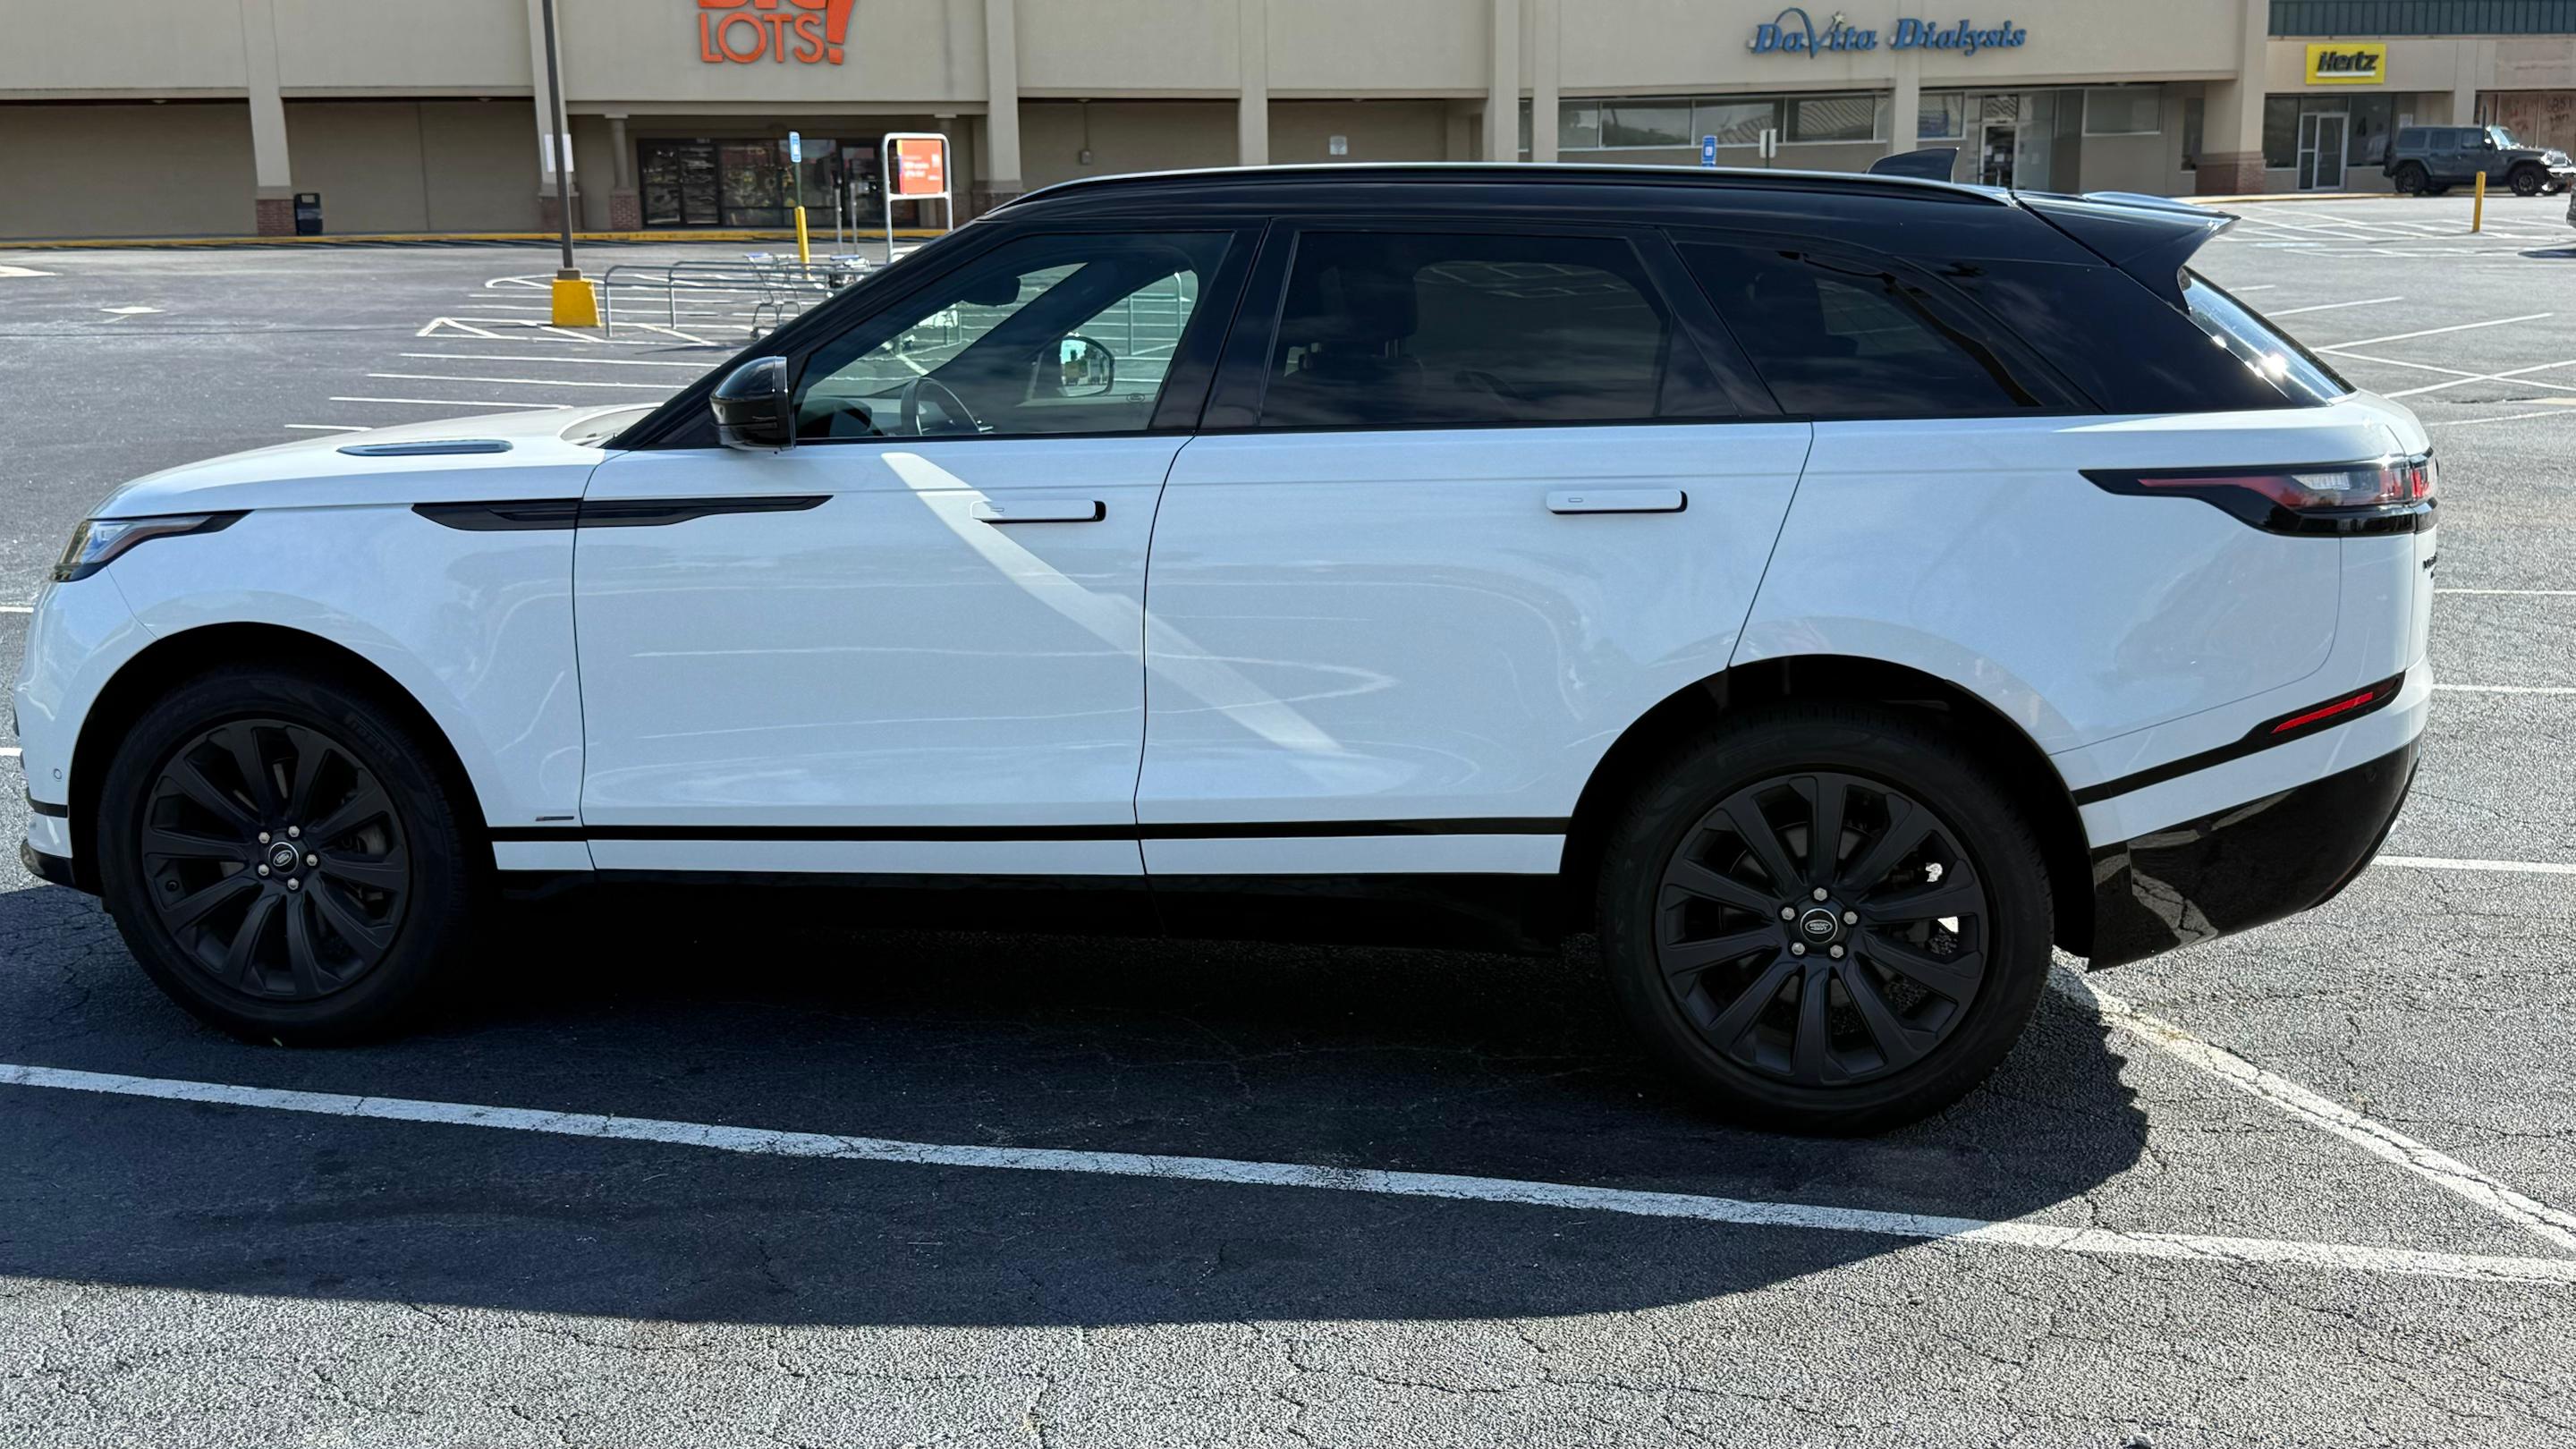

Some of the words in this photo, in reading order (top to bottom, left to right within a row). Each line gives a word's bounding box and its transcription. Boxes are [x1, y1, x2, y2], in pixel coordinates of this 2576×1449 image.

[699, 0, 854, 65] LOTS!
[1750, 7, 1877, 59] DaVita
[1891, 18, 2027, 56] Dialysis
[2317, 51, 2379, 72] Hertz
